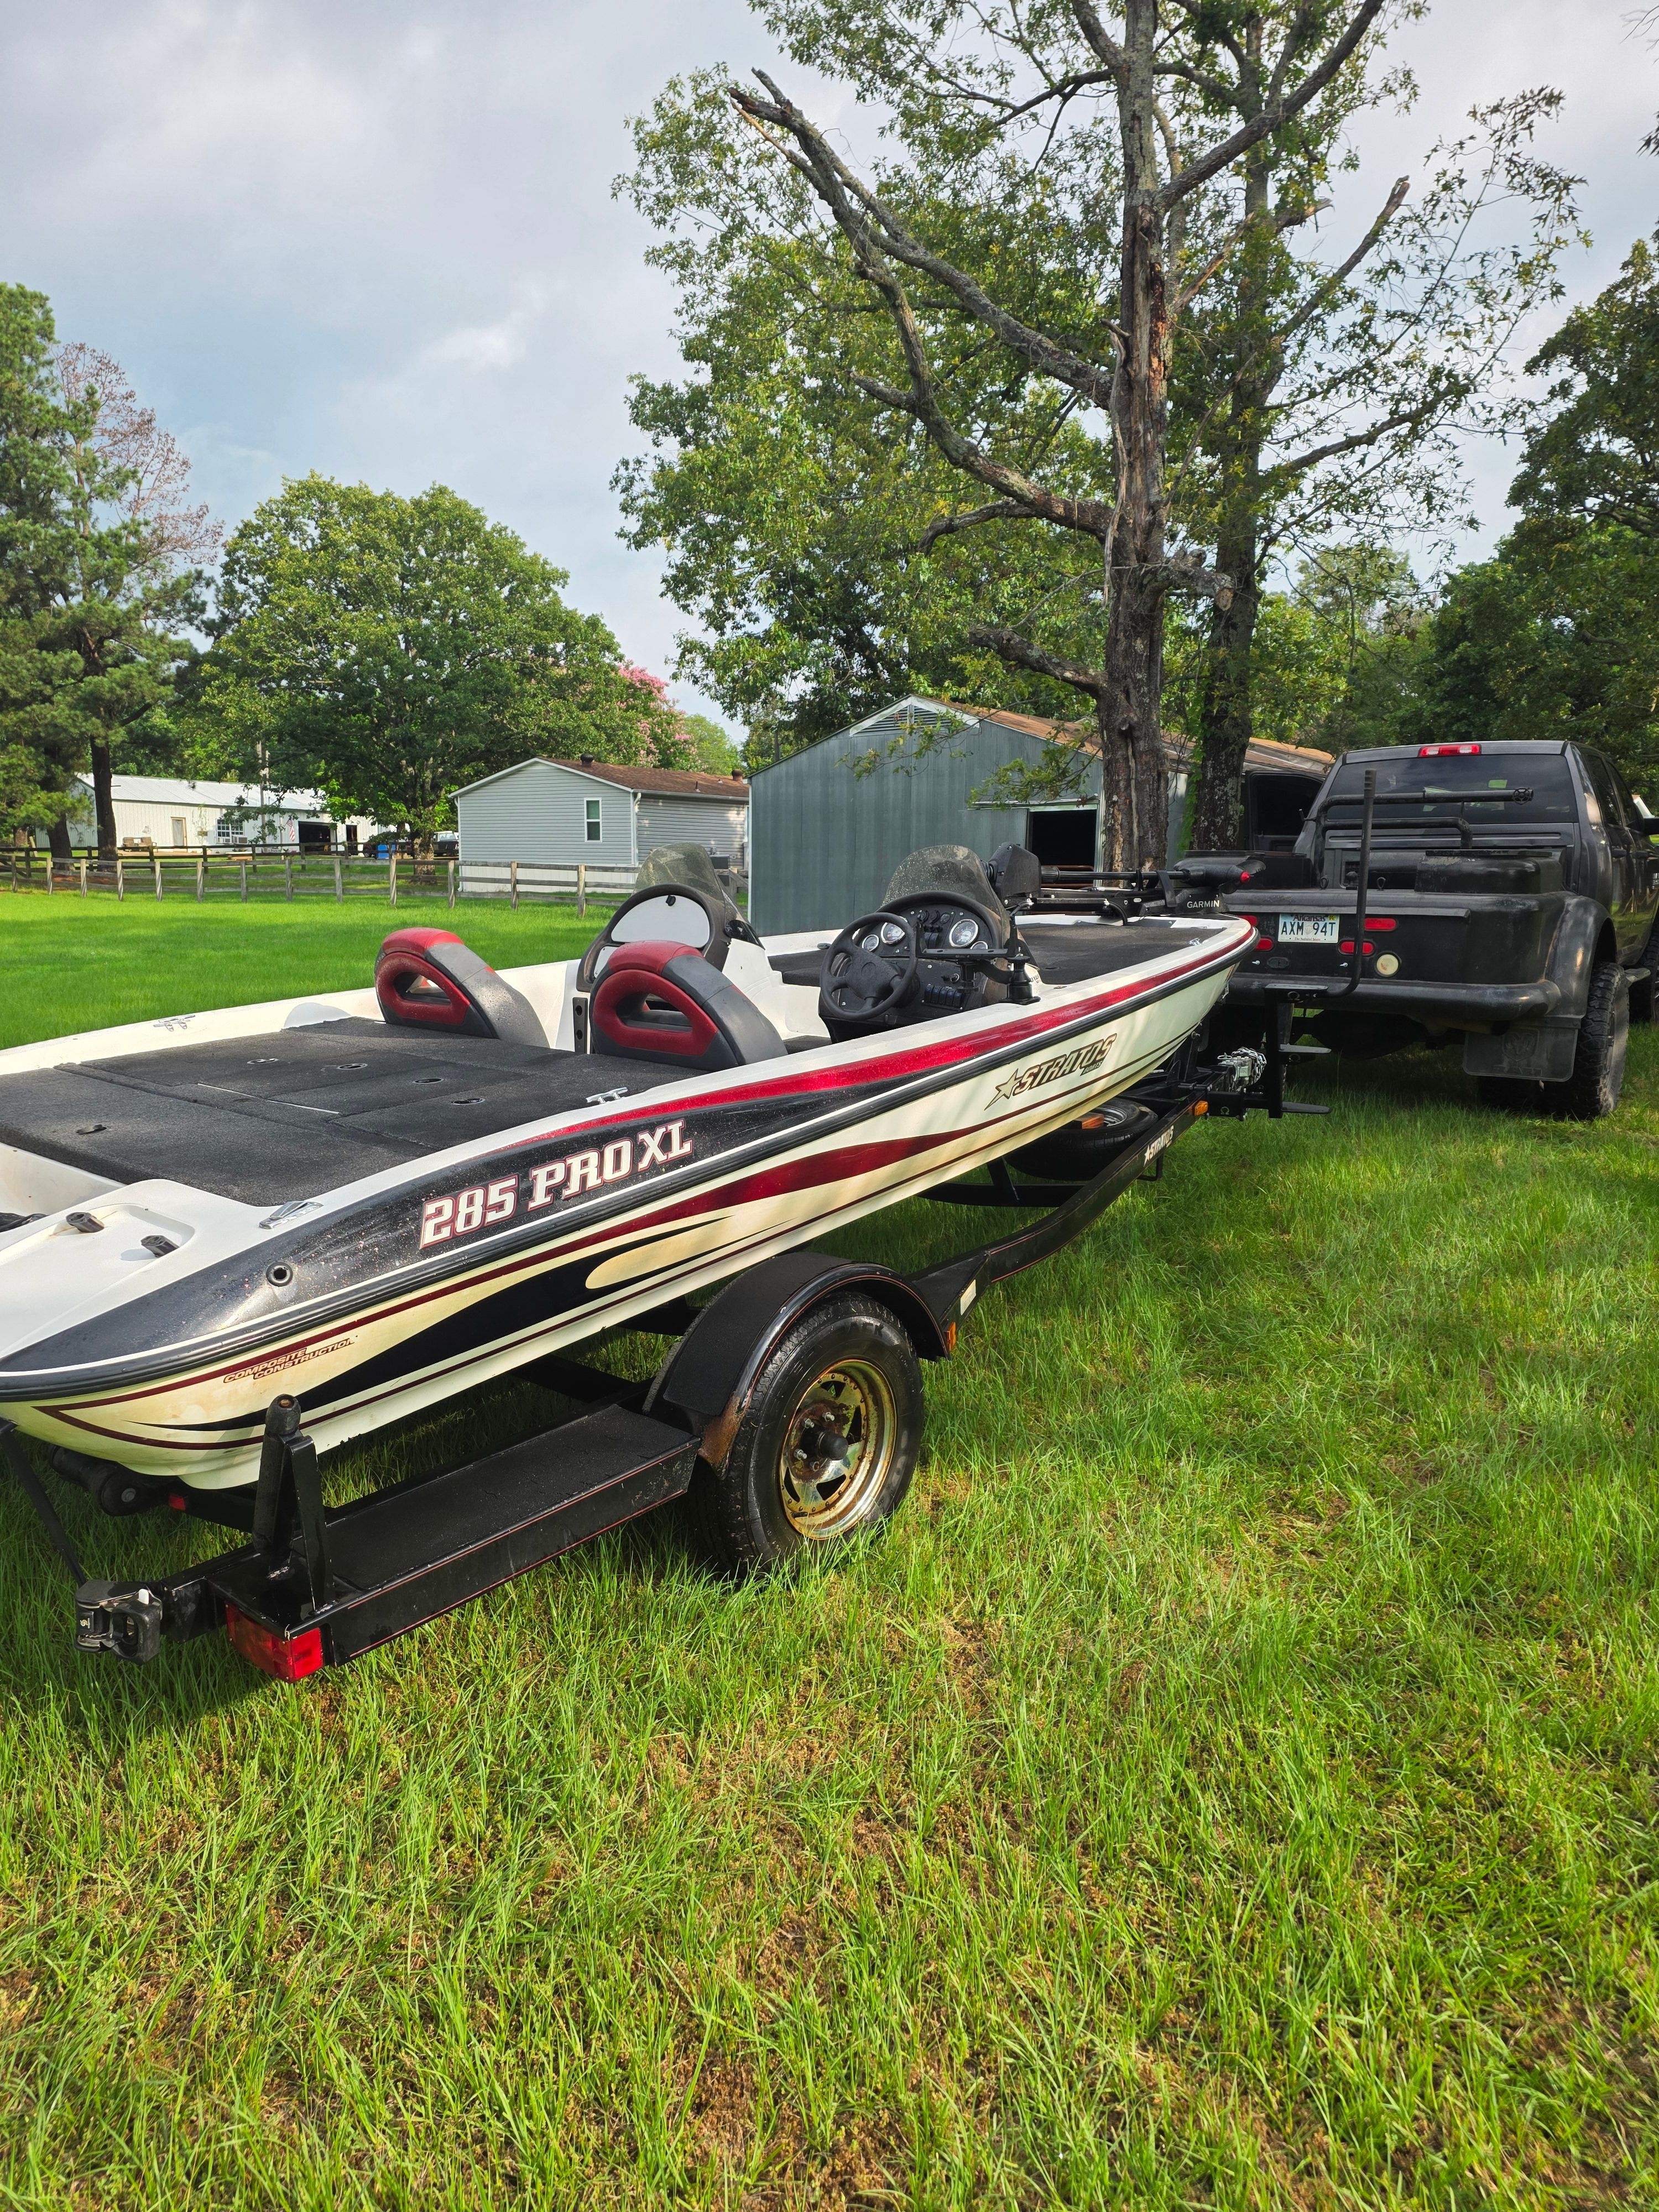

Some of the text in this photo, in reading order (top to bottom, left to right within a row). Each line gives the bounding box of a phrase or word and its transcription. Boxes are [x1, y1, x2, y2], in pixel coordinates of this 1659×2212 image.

[1187, 900, 1220, 908] GARMIN
[1281, 921, 1336, 936] AXM 94T
[1013, 1033, 1117, 1097] STRATOS
[1082, 1061, 1103, 1074] BOATS
[419, 1119, 693, 1249] 285 PRO XL
[223, 1348, 307, 1383] COMPOSITE
